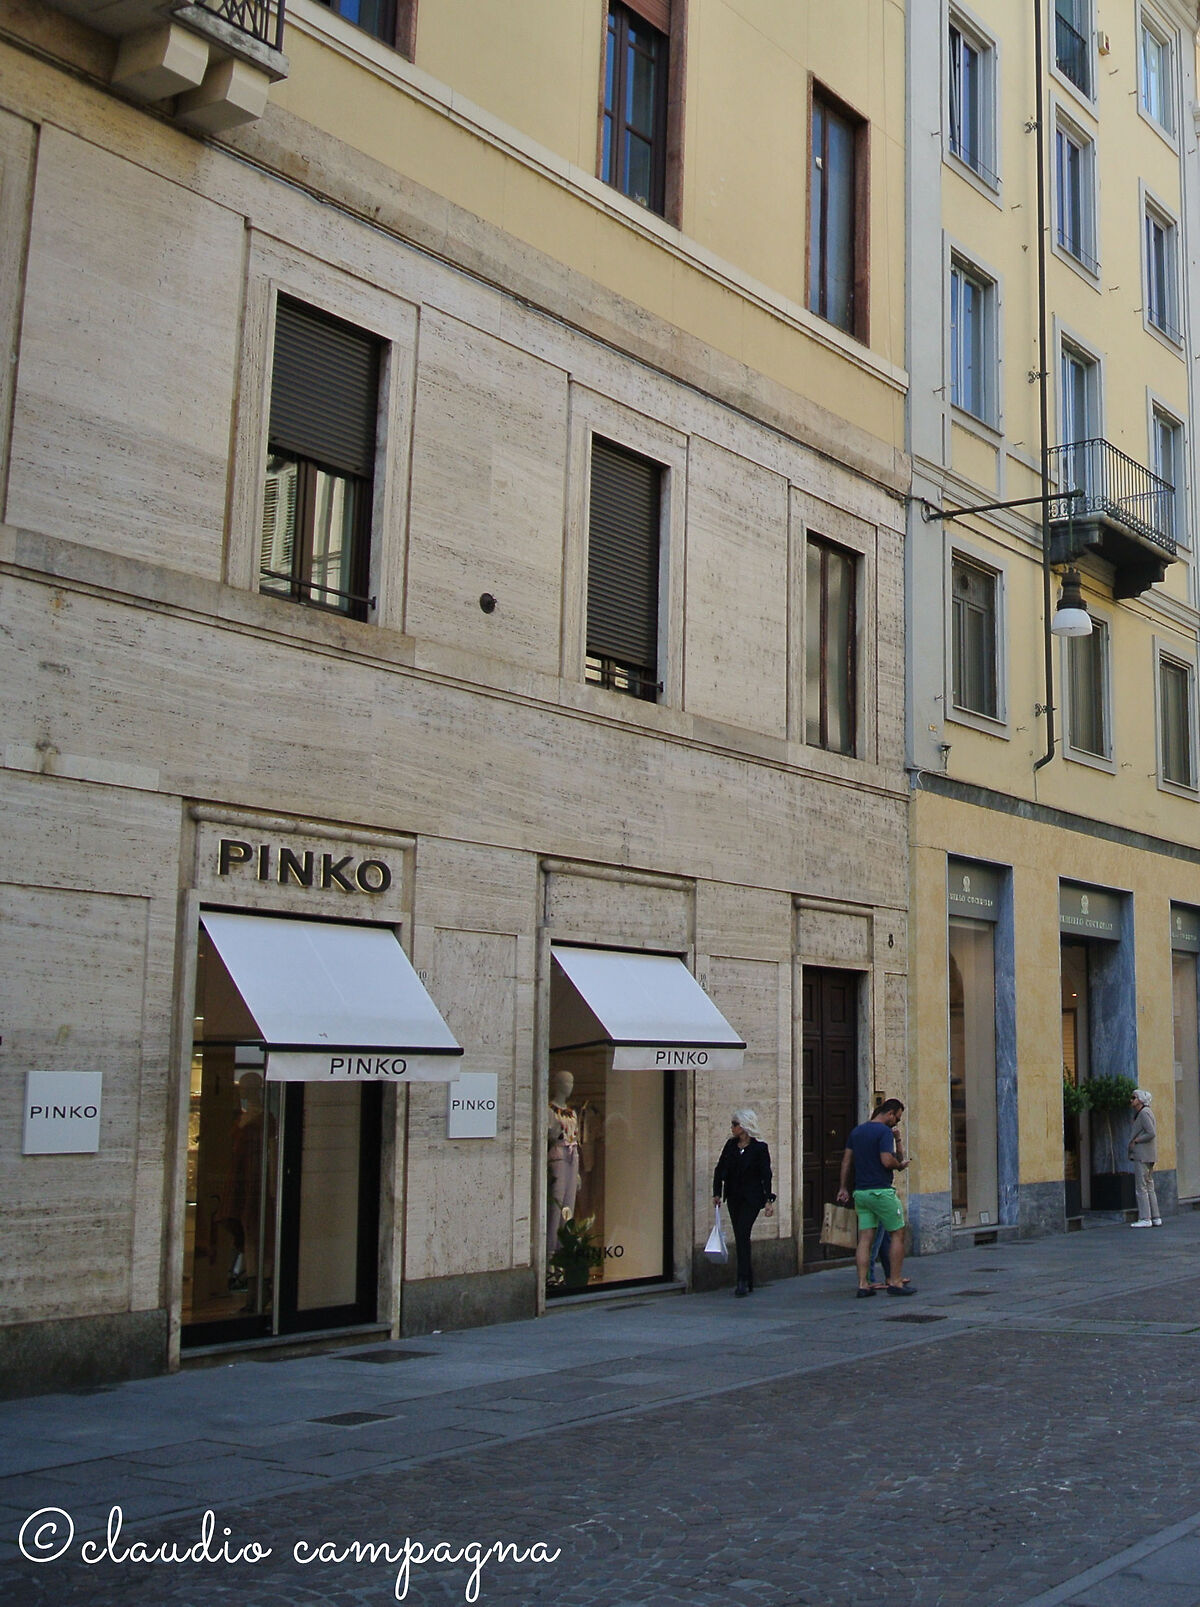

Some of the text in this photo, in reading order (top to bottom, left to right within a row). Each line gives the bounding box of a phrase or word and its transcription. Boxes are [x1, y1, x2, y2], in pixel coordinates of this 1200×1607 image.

[217, 838, 392, 894] PINKO
[655, 1050, 708, 1065] PINKO
[329, 1057, 408, 1075] PINKO
[30, 1105, 98, 1119] PINKO
[451, 1100, 496, 1110] PINKO
